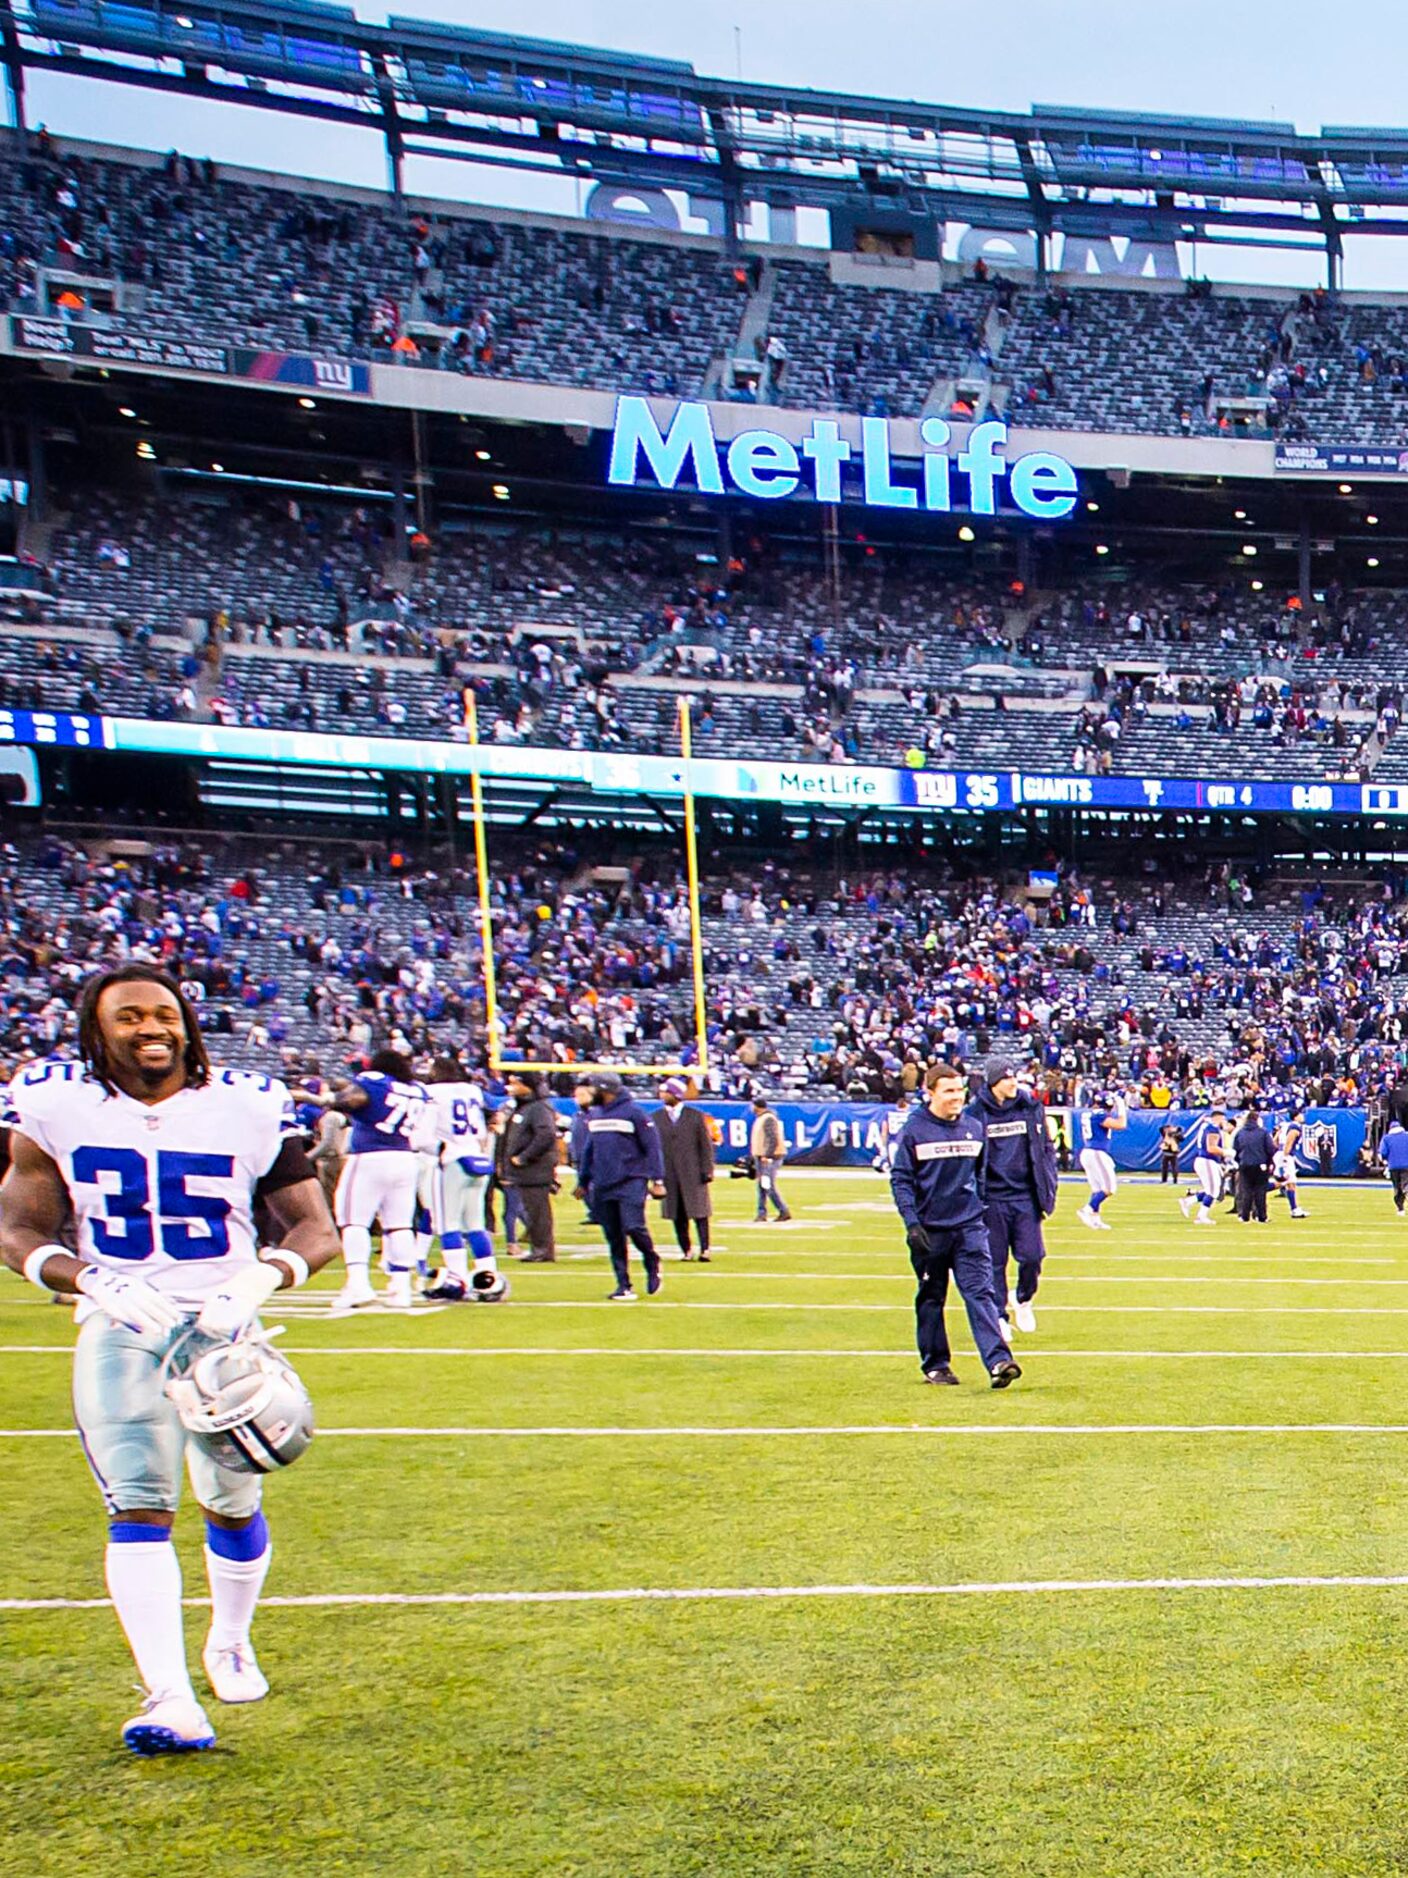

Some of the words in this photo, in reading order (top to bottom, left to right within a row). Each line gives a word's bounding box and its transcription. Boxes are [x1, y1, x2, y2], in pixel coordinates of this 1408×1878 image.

[608, 395, 1078, 518] MetLife
[1275, 457, 1328, 470] CHAMPIONS
[1284, 446, 1318, 458] WORLD
[780, 773, 877, 795] MetLife
[966, 775, 999, 807] 35
[1023, 776, 1093, 802] GIANTS
[1240, 786, 1253, 806] 4
[71, 1145, 235, 1261] 35
